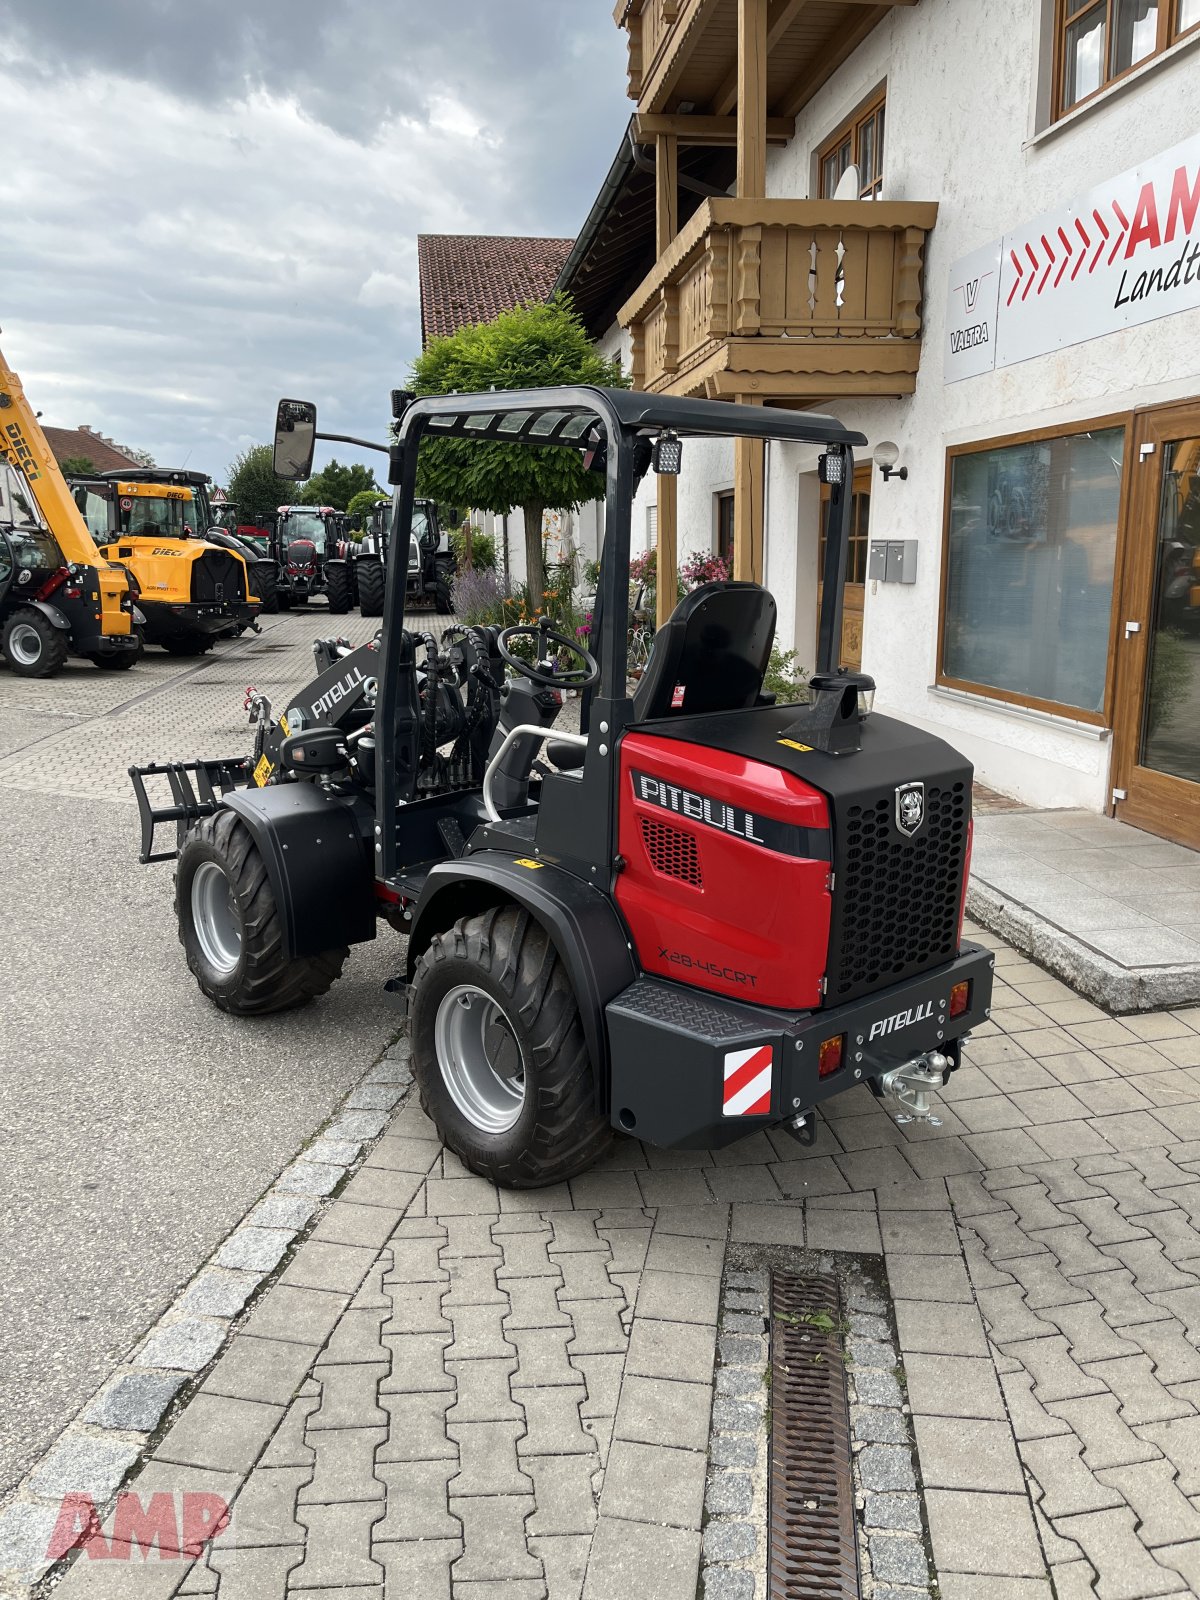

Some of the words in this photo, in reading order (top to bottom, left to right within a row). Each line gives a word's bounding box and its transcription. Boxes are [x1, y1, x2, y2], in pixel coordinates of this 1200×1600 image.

[1114, 240, 1200, 309] Landt
[950, 322, 989, 354] VALTRA
[166, 491, 185, 499] DIECI
[151, 547, 185, 557] DIECI
[20, 572, 29, 582] 20
[310, 666, 368, 720] PITBULL
[639, 774, 765, 843] PITBULL
[657, 945, 758, 988] X28-45CRT
[868, 999, 934, 1042] PITBULL
